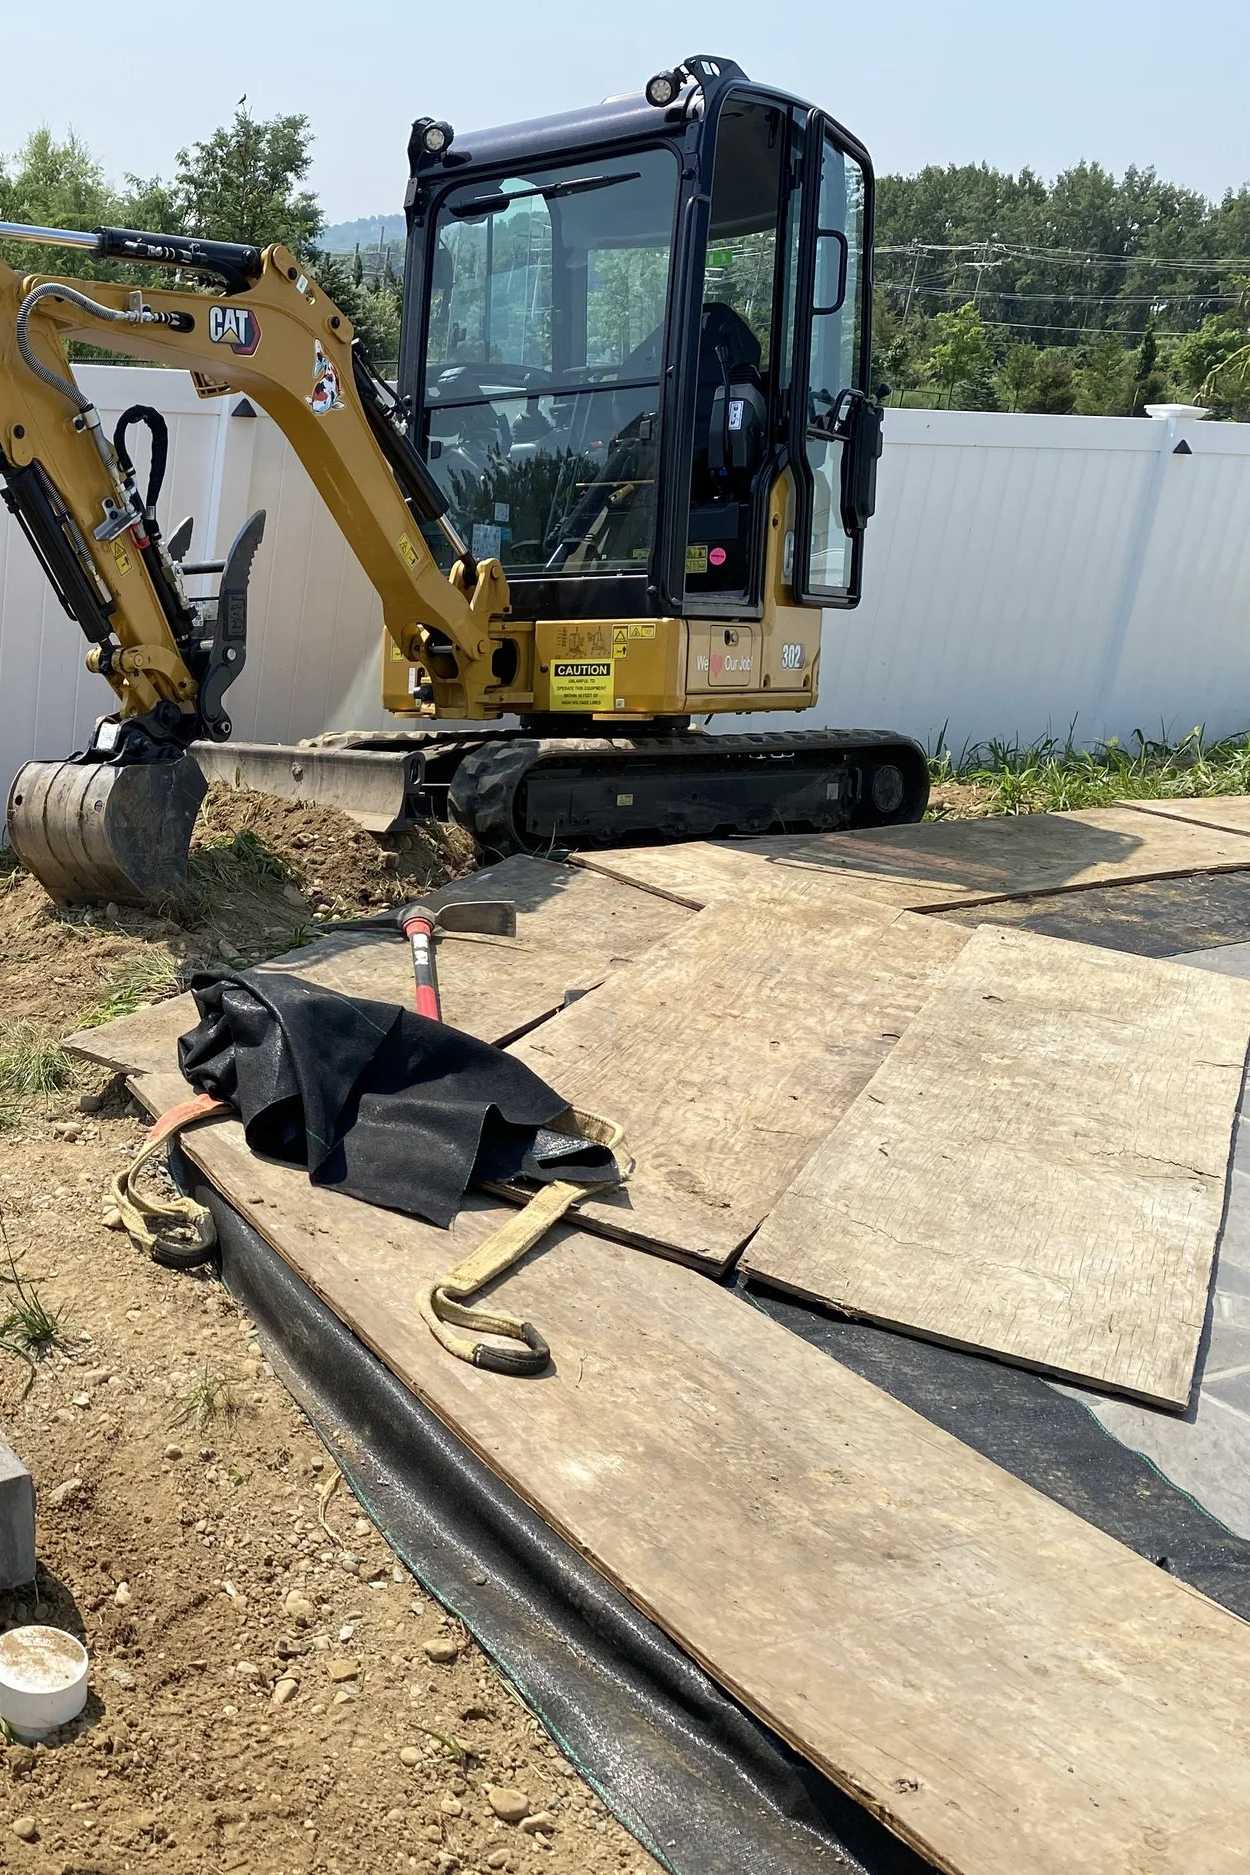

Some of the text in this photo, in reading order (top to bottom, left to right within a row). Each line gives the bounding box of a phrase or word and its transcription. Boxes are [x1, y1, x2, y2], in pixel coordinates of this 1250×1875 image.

[209, 306, 249, 344] CAT
[697, 655, 709, 671] We
[724, 655, 738, 671] Our
[782, 644, 803, 669] 302
[557, 665, 607, 675] CAUTION
